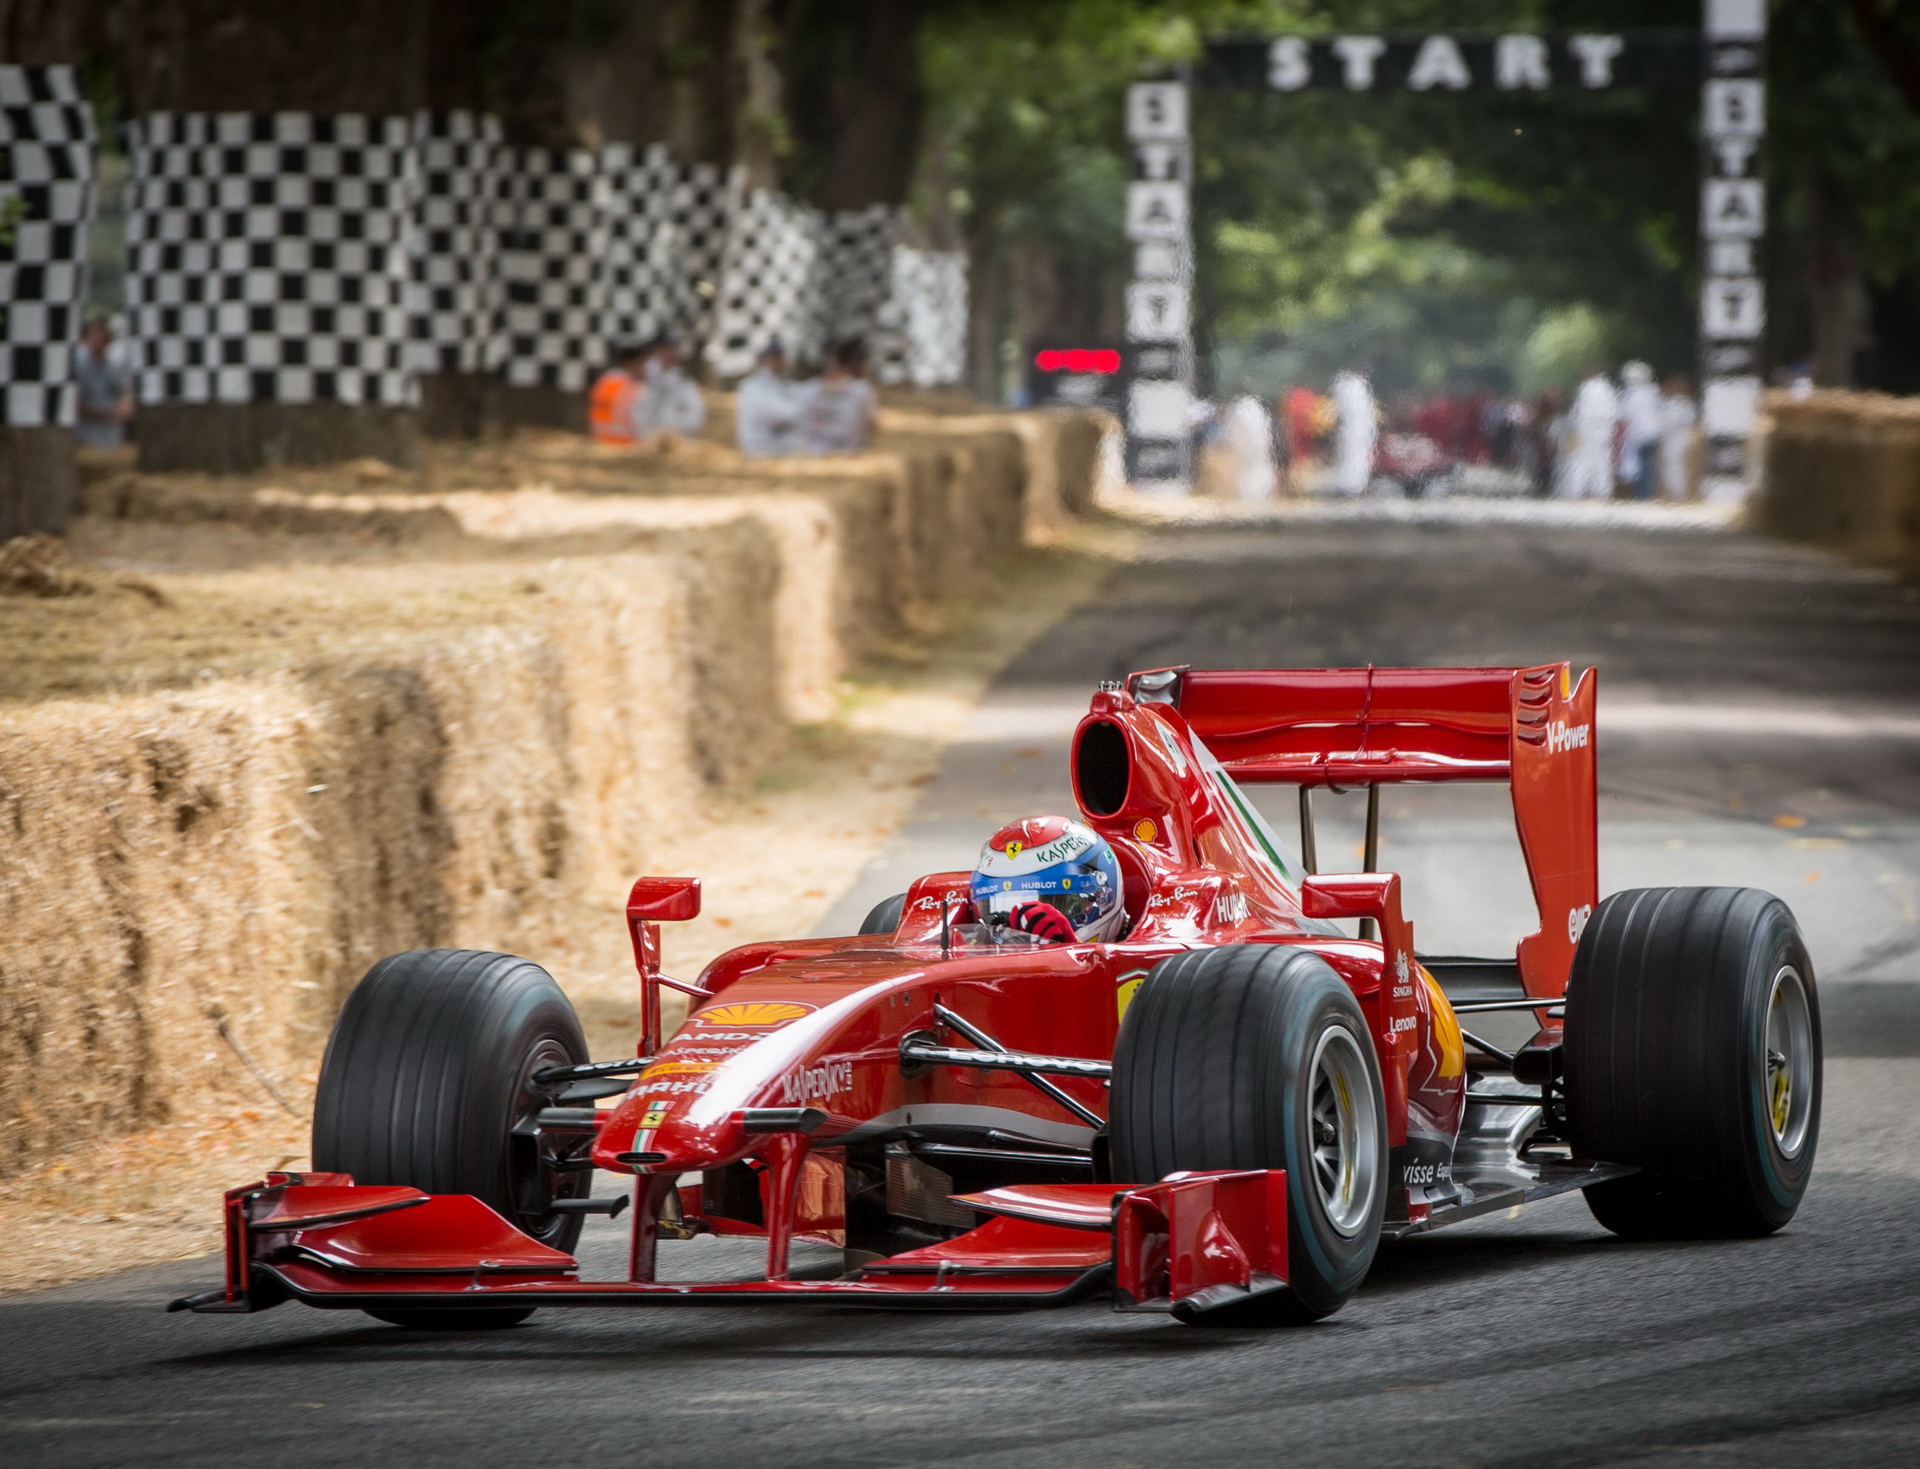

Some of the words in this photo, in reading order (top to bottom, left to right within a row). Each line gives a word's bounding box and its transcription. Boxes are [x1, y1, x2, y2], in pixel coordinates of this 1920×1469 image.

[1267, 33, 1625, 92] START
[1546, 720, 1590, 754] V-Power
[976, 884, 999, 895] HUBLOT
[1021, 880, 1058, 889] HUBLOT
[1149, 886, 1199, 908] Ray-Ban
[1392, 985, 1413, 998] SINGHA
[1390, 1015, 1417, 1034] Lenovo
[625, 1080, 713, 1102] MAHL
[780, 1060, 846, 1107] KASPERSKY
